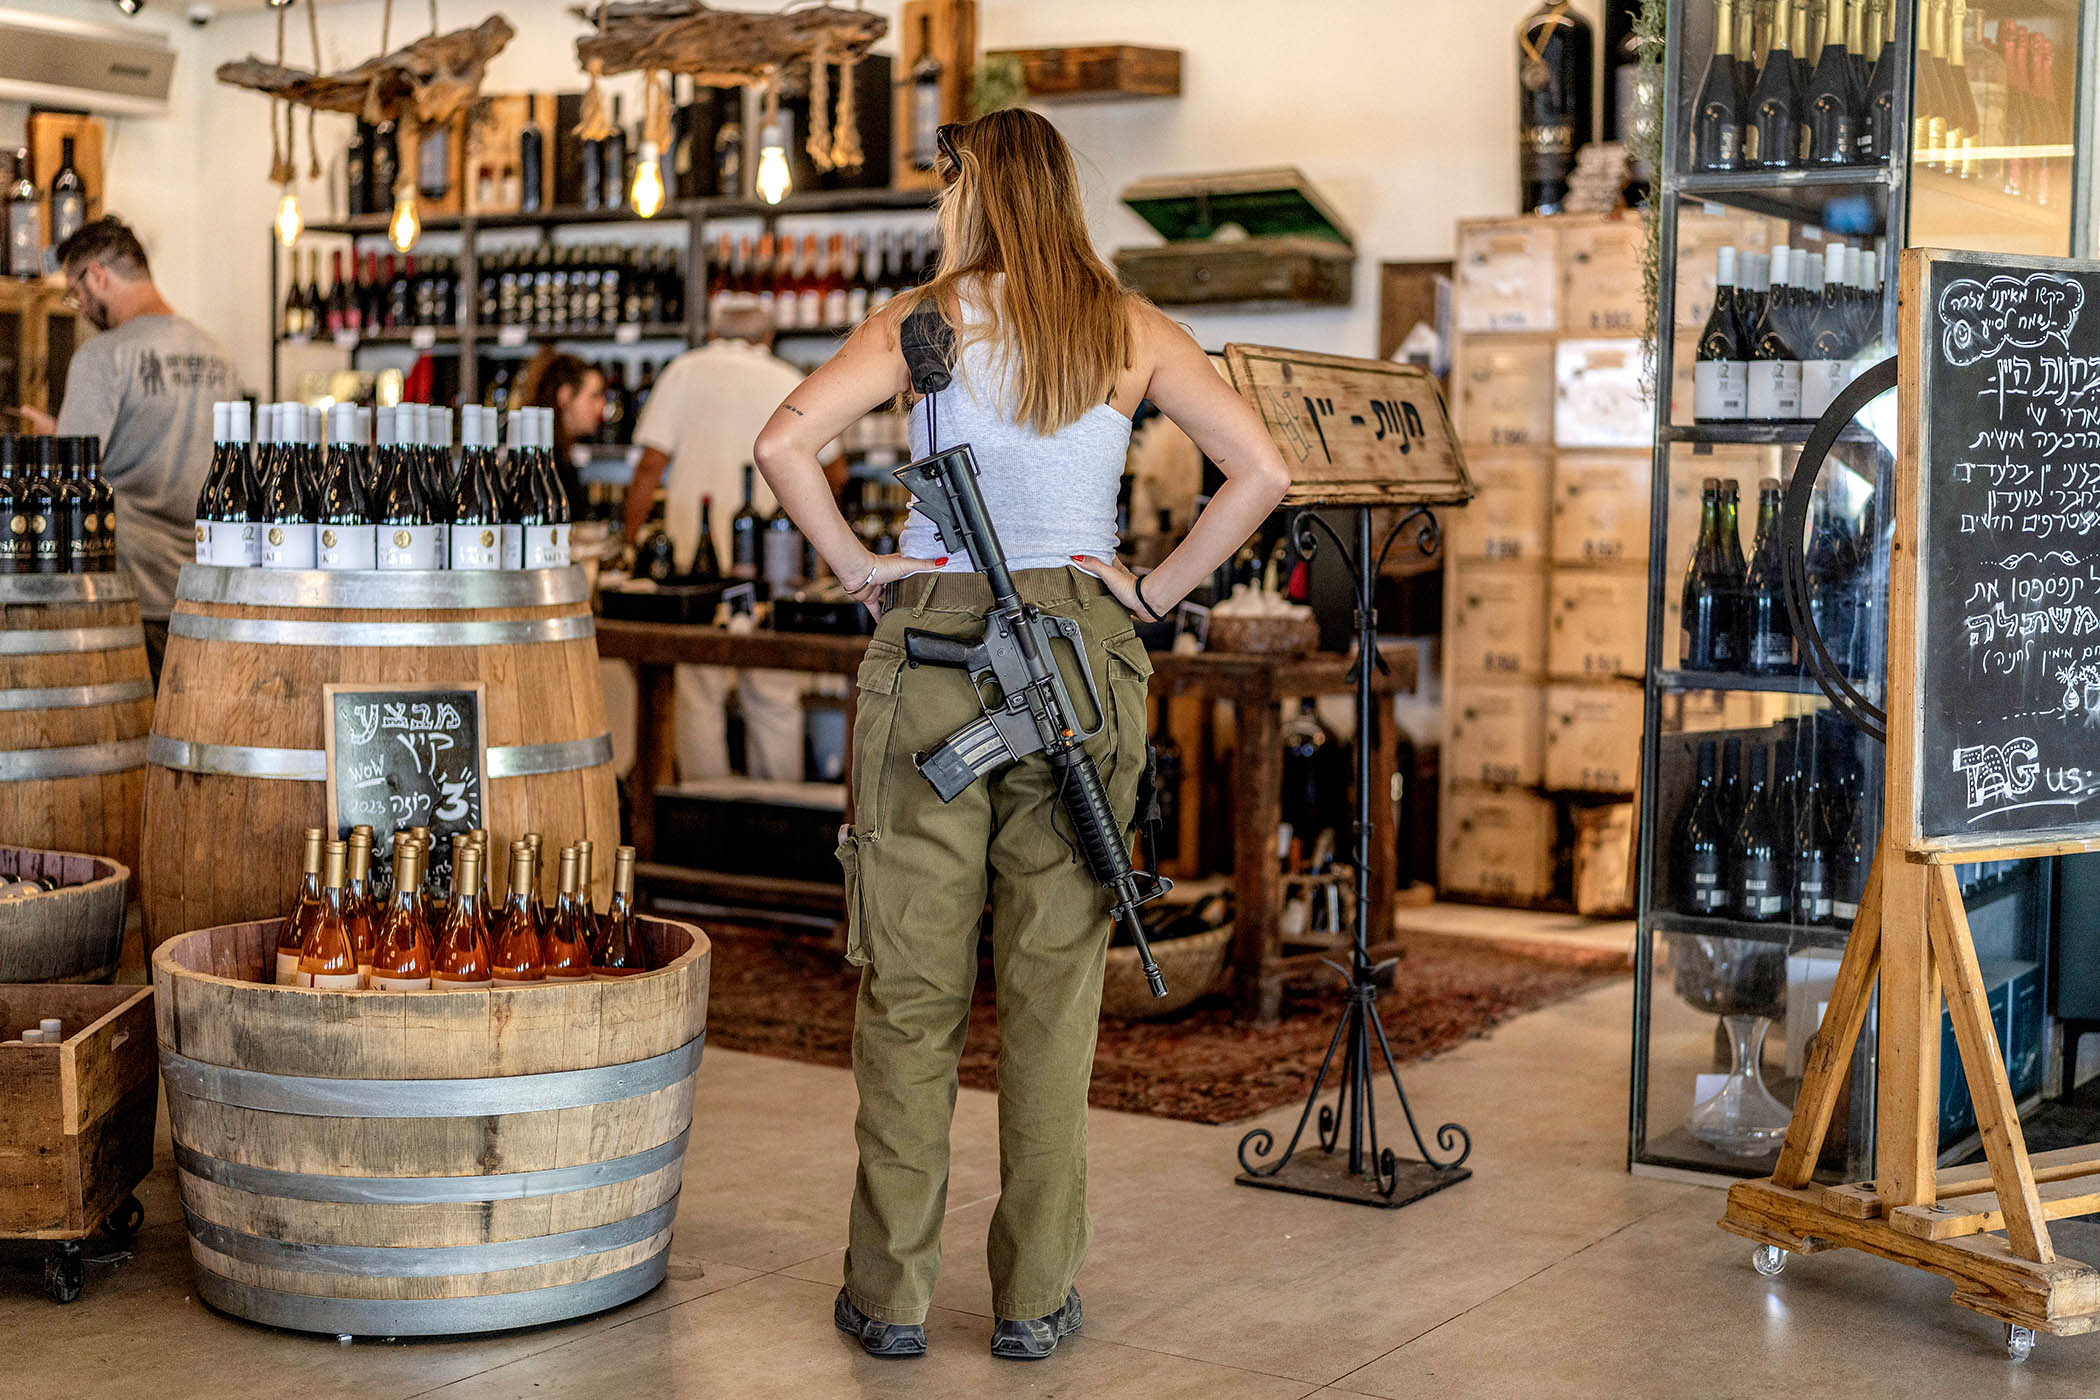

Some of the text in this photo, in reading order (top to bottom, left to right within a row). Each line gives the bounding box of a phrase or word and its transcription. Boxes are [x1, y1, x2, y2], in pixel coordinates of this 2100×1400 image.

[1950, 290, 1985, 311] עזרה
[2035, 286, 2065, 319] בקשו
[1981, 308, 2017, 340] לסייע
[1303, 396, 1335, 465] יין
[1370, 400, 1425, 455] חנות
[2027, 402, 2100, 429] ארזי שי
[1968, 428, 2100, 457] הרכבה אישית
[2040, 464, 2052, 497] יין
[1987, 490, 2043, 520] מועדון
[1960, 512, 2013, 533] חדשים
[1965, 578, 1999, 607] את
[2012, 576, 2084, 605] תפספסו
[341, 702, 461, 745] מבצע
[397, 732, 455, 776] קיץ
[1952, 736, 2040, 809] TAG
[436, 782, 469, 822] 3
